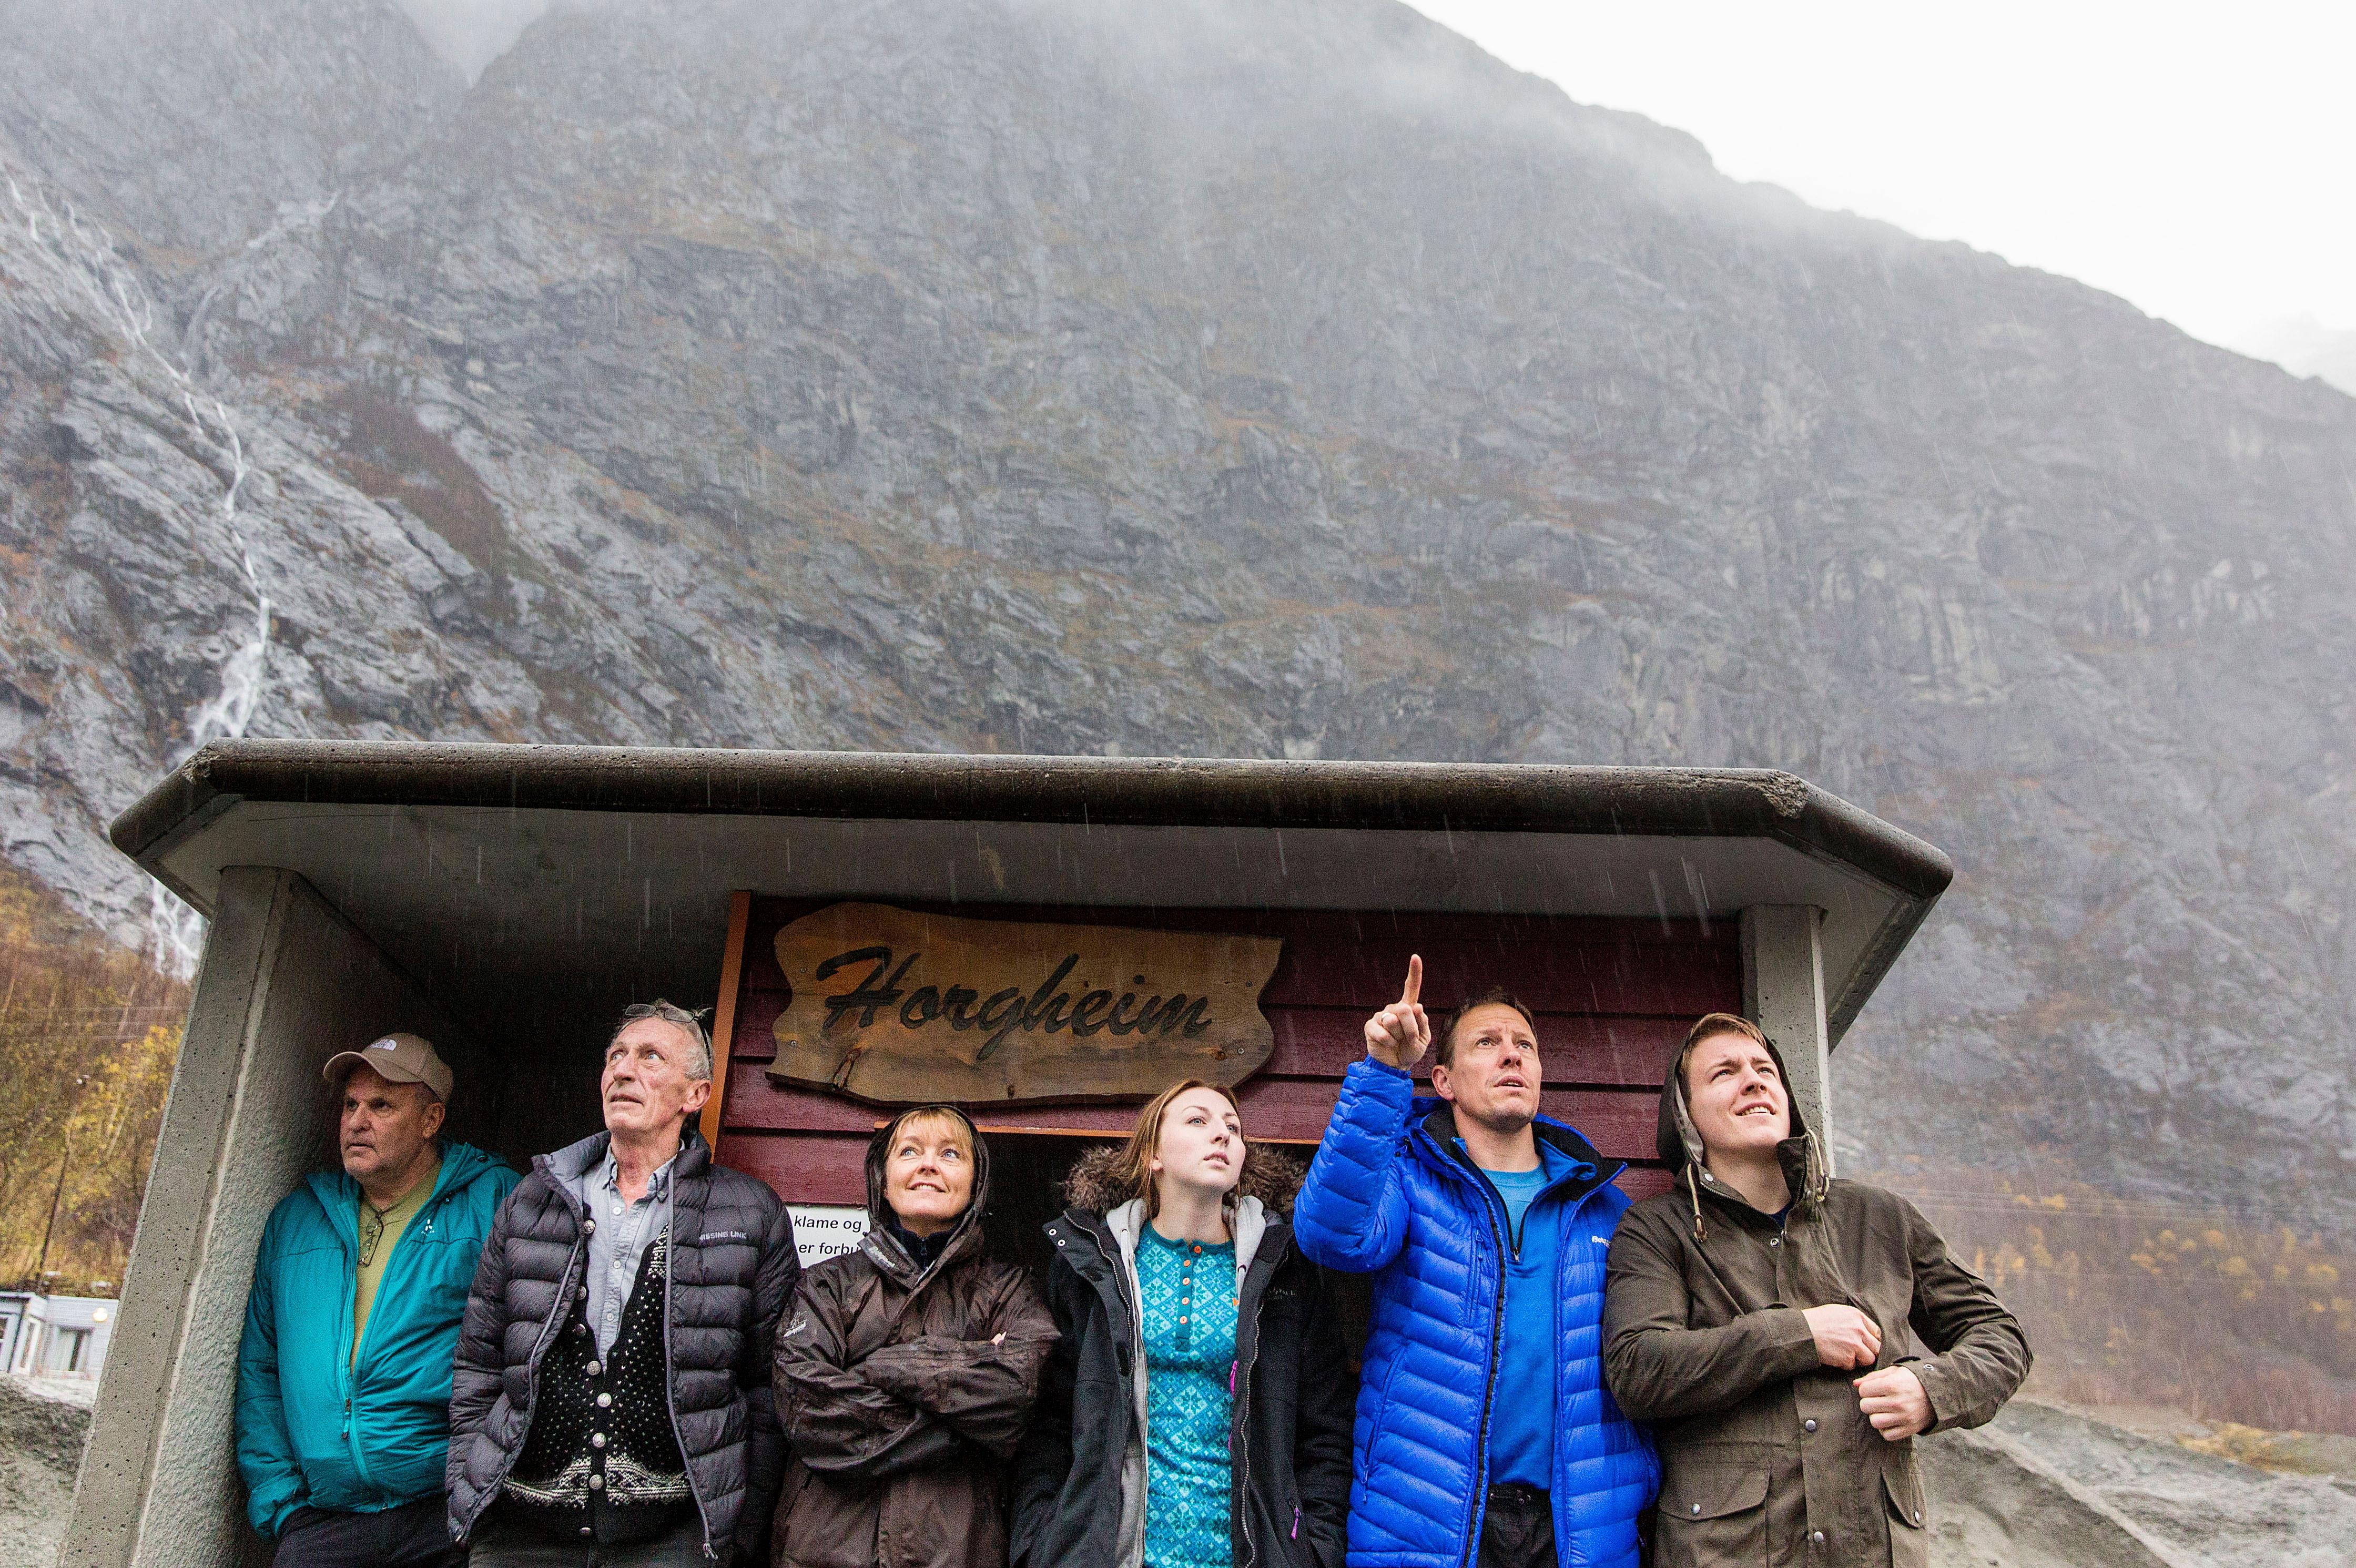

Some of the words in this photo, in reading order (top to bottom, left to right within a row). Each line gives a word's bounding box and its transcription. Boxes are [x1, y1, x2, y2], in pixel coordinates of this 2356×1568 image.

[816, 946, 1212, 1061] Horgheim
[794, 1215, 838, 1229] klame
[843, 1220, 861, 1233] og
[799, 1244, 815, 1254] er
